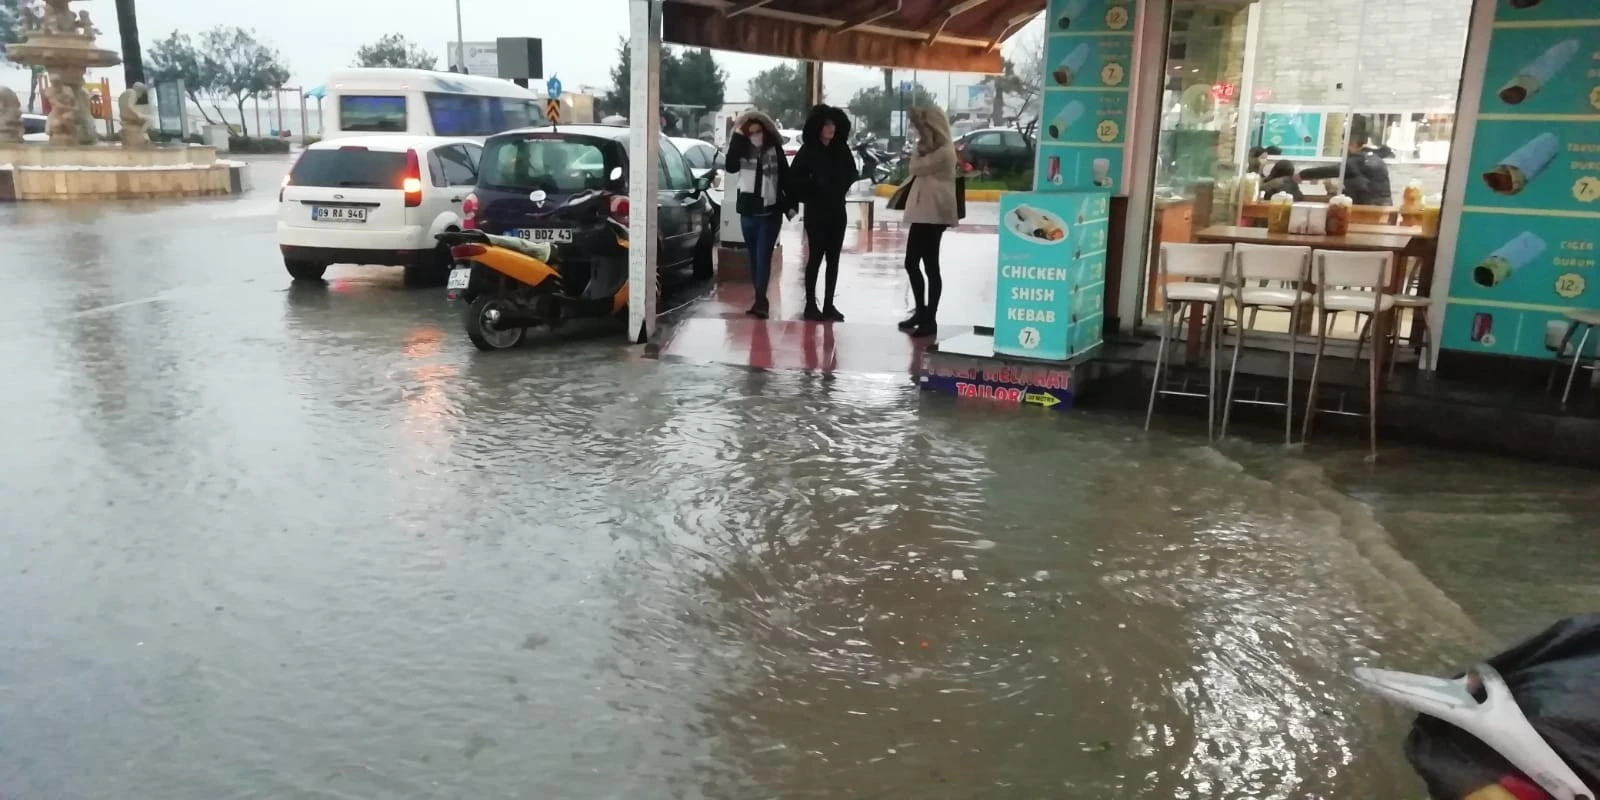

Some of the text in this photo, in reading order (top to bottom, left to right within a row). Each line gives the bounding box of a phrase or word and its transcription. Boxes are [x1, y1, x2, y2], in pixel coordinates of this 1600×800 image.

[318, 208, 364, 219] 09 RA 946
[518, 229, 571, 240] 09 BDZ 43
[1002, 264, 1066, 281] CHICKEN
[1011, 287, 1055, 301] SHISH
[1007, 307, 1056, 323] KEBAB
[955, 382, 1021, 402] TAILOR
